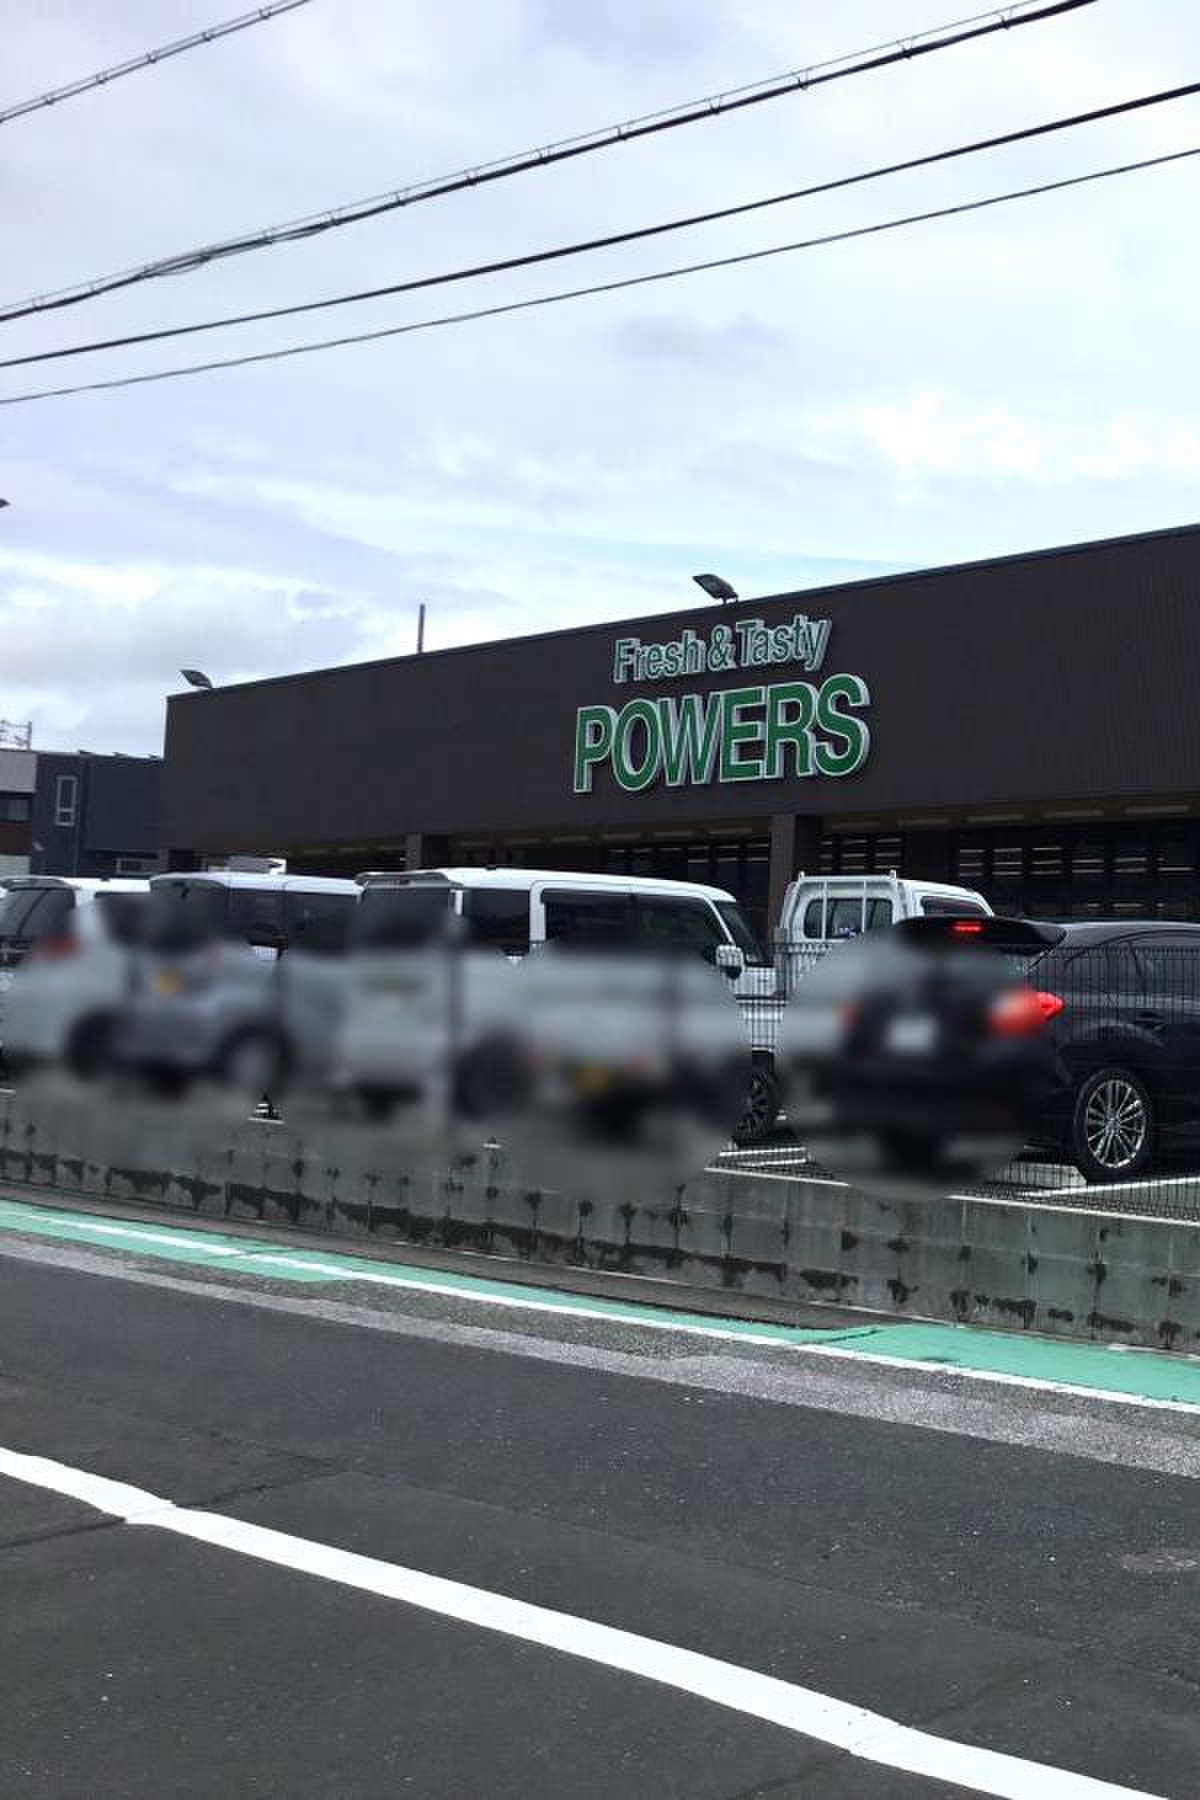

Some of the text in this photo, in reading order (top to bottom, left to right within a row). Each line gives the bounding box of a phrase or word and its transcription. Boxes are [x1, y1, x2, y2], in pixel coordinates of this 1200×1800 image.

[613, 614, 832, 683] Fresh & Tasty
[574, 673, 871, 793] POWERS
